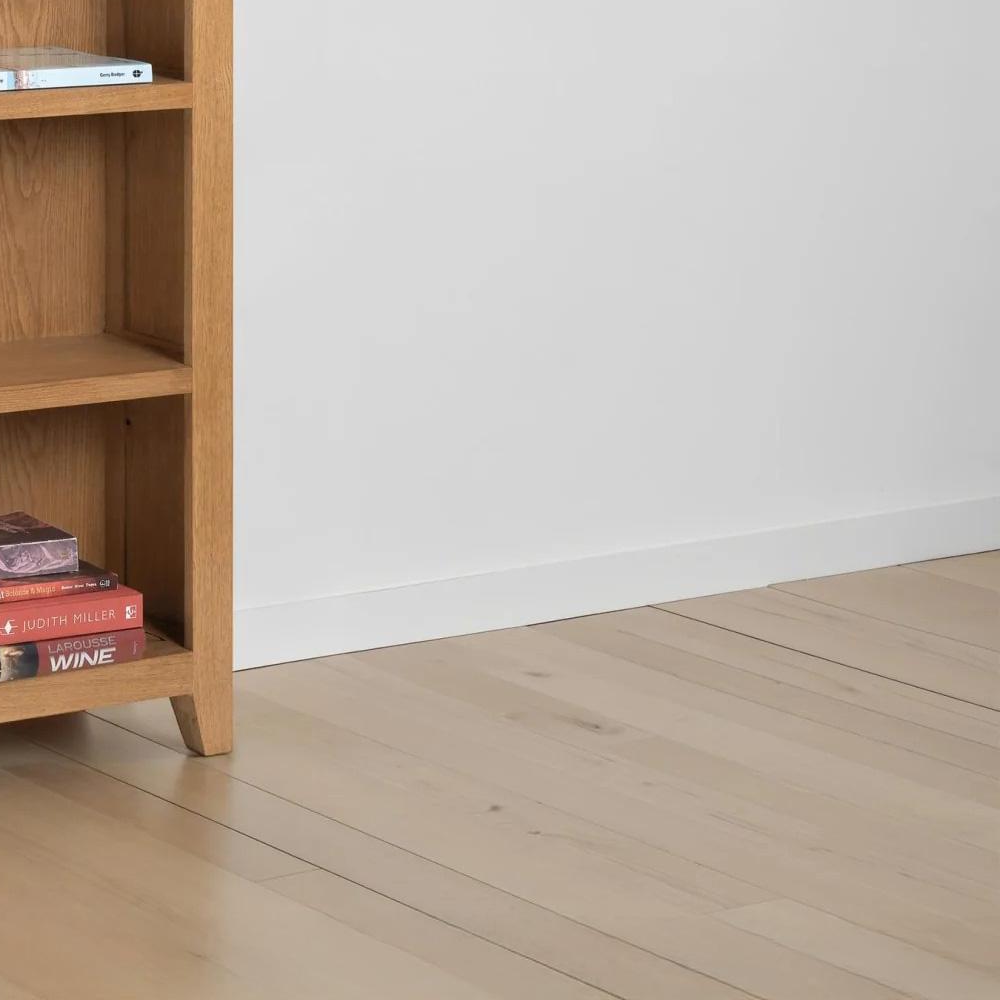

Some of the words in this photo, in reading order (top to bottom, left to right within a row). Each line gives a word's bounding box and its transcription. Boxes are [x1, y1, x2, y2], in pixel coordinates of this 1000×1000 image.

[5, 589, 29, 598] Science
[36, 586, 56, 596] Magic
[22, 615, 68, 633] JUDITH
[73, 609, 116, 624] MILLER
[48, 636, 117, 654] LAROUSSE
[49, 647, 117, 672] WINE
